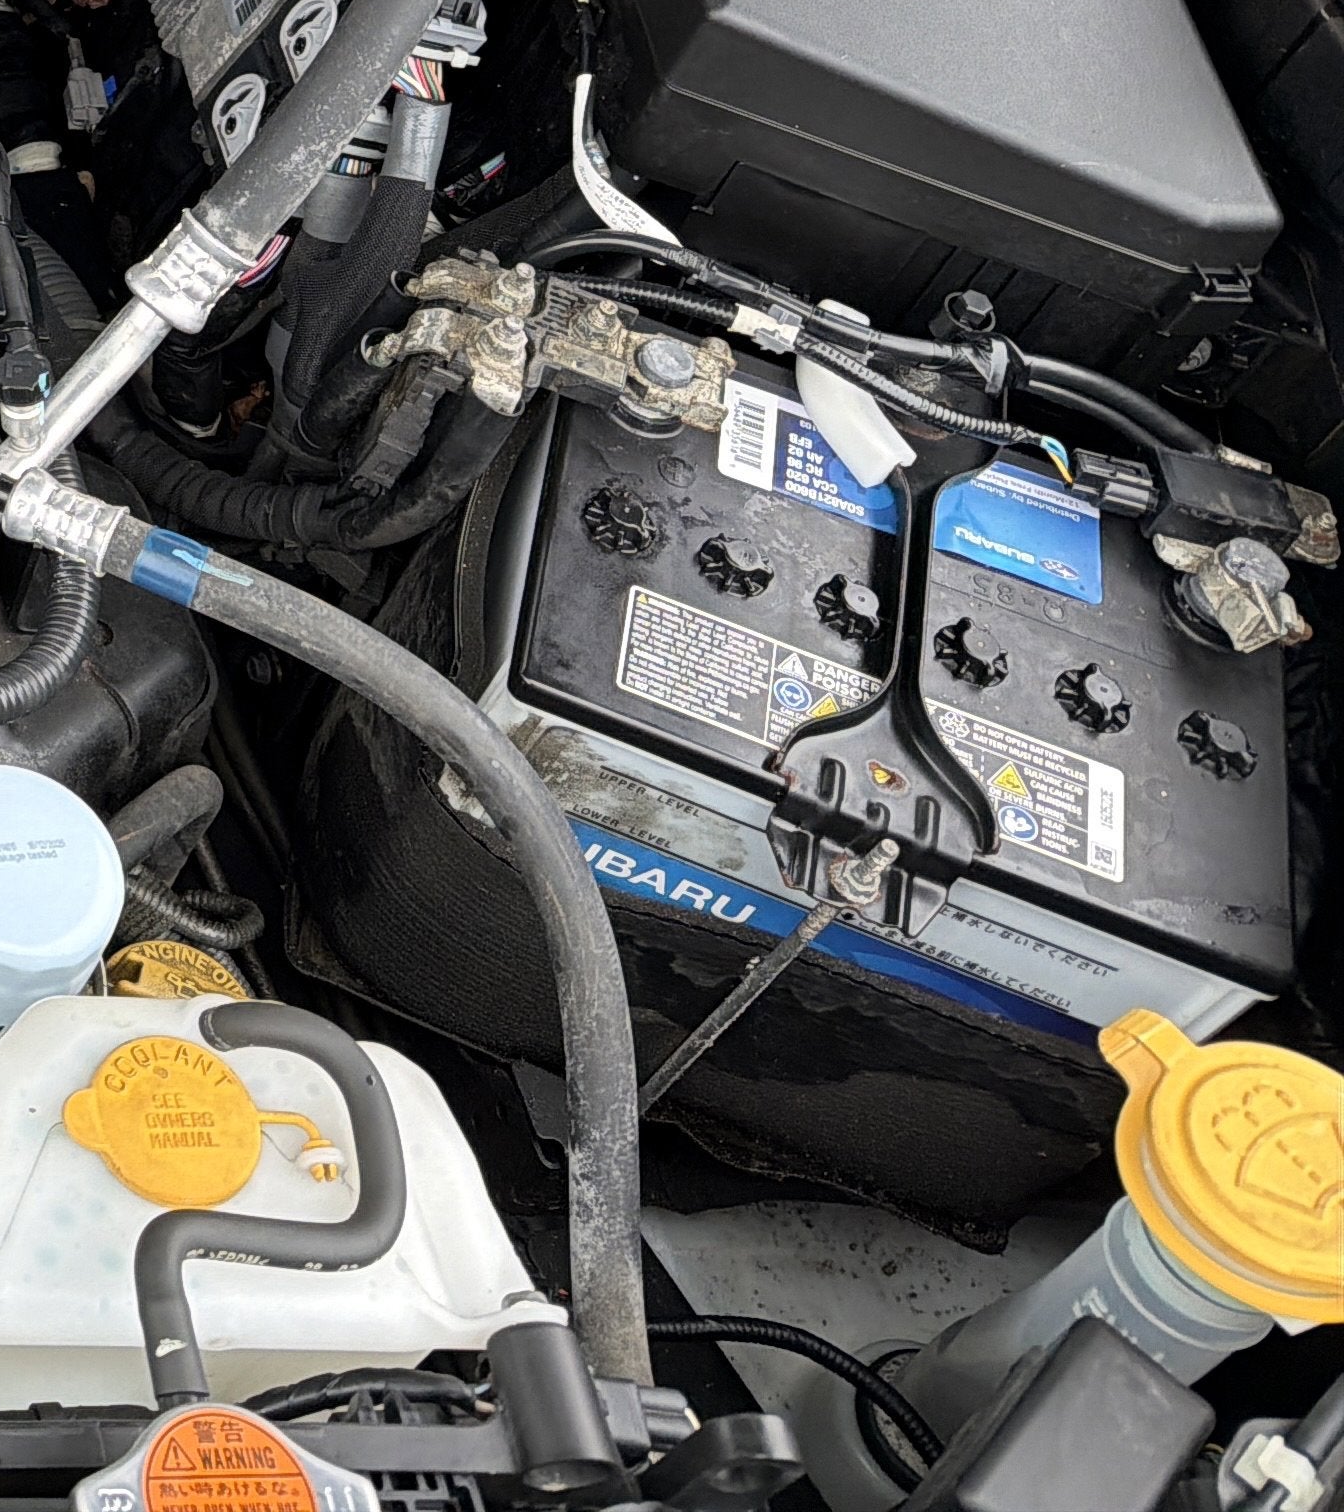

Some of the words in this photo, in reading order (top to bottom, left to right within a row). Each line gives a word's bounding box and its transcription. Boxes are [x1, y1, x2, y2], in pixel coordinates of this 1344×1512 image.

[789, 433, 813, 447] EFB
[813, 477, 838, 495] CCA
[1026, 498, 1080, 522] Distributed
[953, 526, 1035, 565] SUBARU
[599, 772, 646, 795] UPPER
[657, 794, 701, 818] LEVEL
[573, 804, 619, 826] LOWER
[629, 826, 672, 849] LEVEL
[104, 1043, 233, 1093] COOLANT
[152, 1093, 186, 1109] SEE
[149, 1132, 220, 1149] MANUAL
[193, 1420, 244, 1444] 警告
[197, 1446, 276, 1471] WARNING
